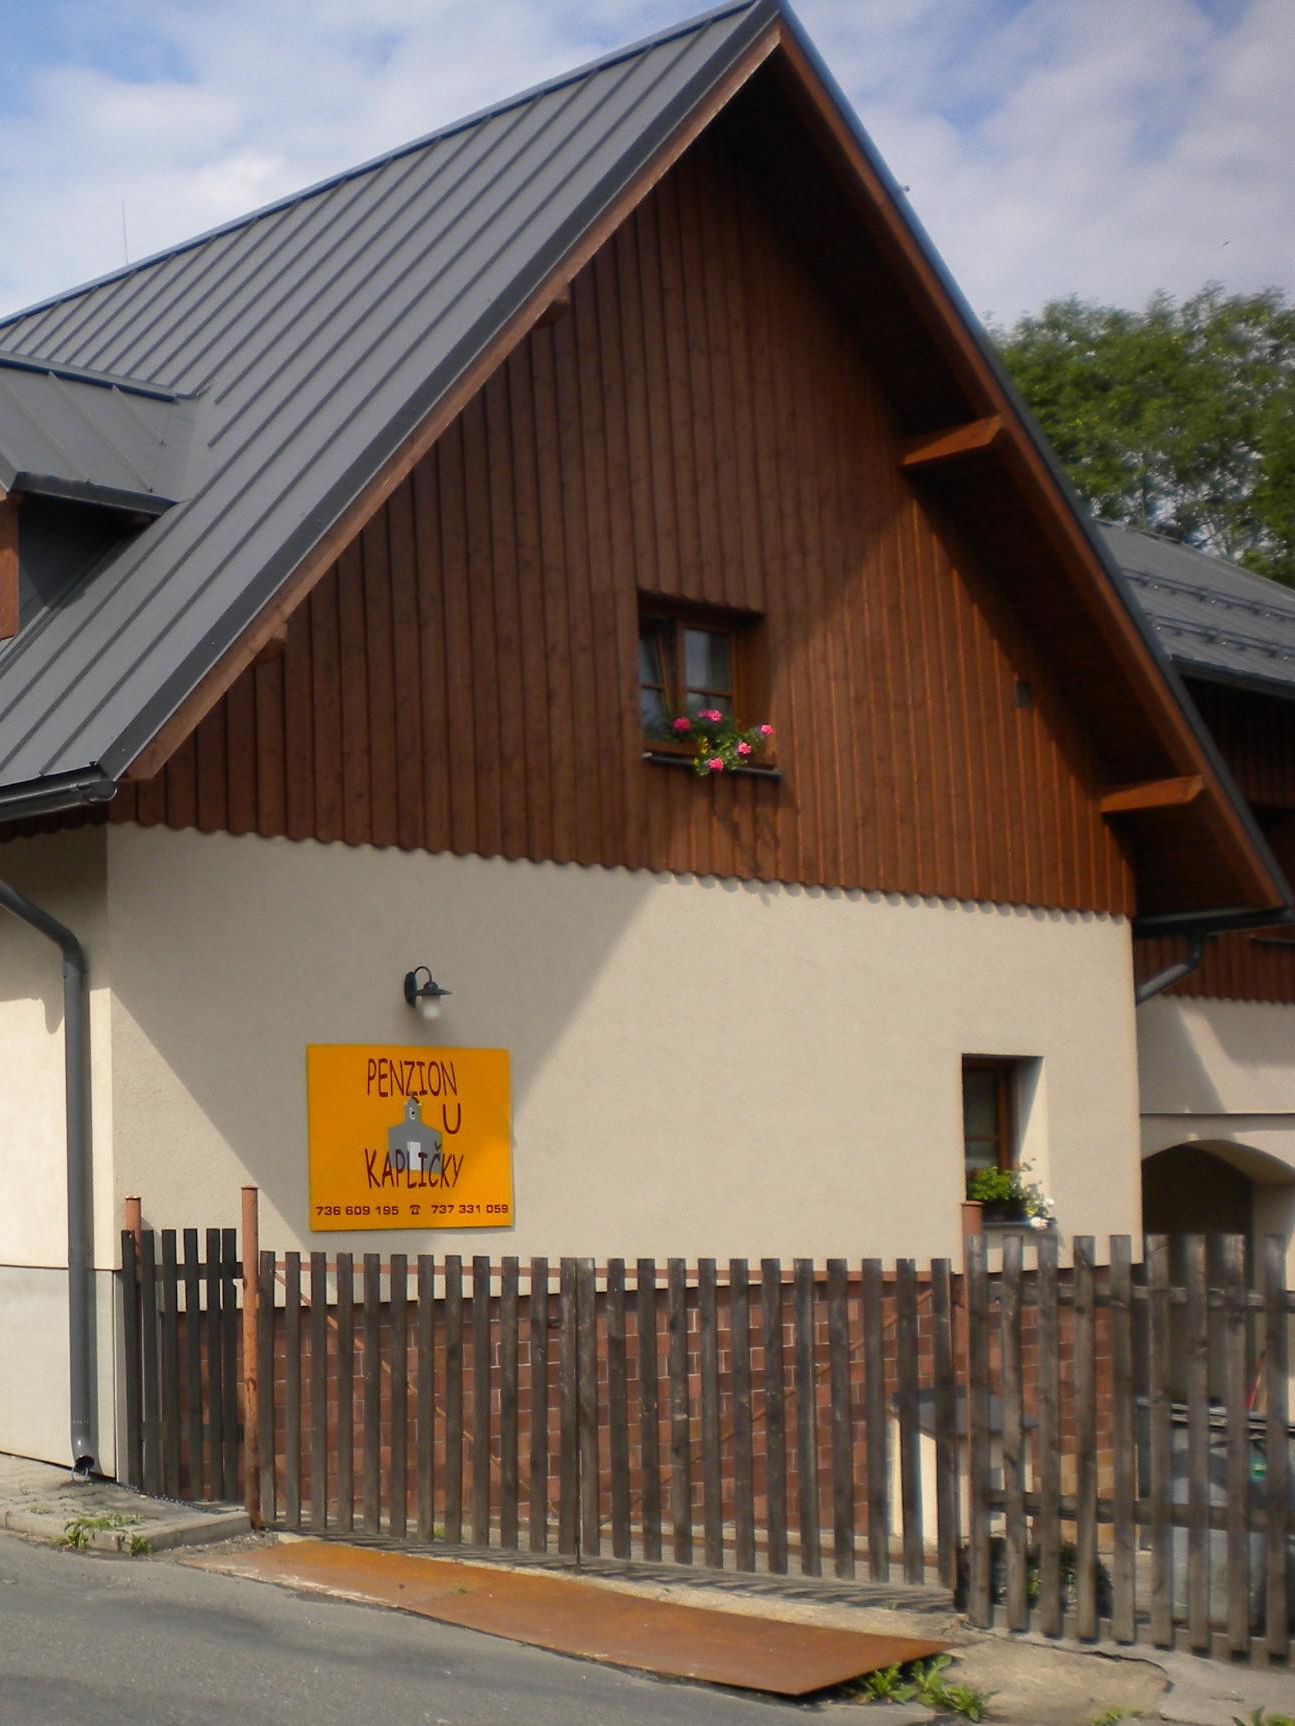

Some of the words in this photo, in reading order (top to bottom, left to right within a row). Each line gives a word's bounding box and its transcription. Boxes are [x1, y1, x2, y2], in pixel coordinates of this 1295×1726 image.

[366, 1058, 458, 1097] PENZION
[443, 1103, 461, 1134] U
[364, 1142, 464, 1189] KAPLIČKY
[316, 1206, 341, 1216] 736
[345, 1206, 370, 1216] 609
[376, 1206, 399, 1216] 195
[432, 1205, 454, 1214] 737
[458, 1204, 481, 1214] 331
[486, 1204, 509, 1214] 059
